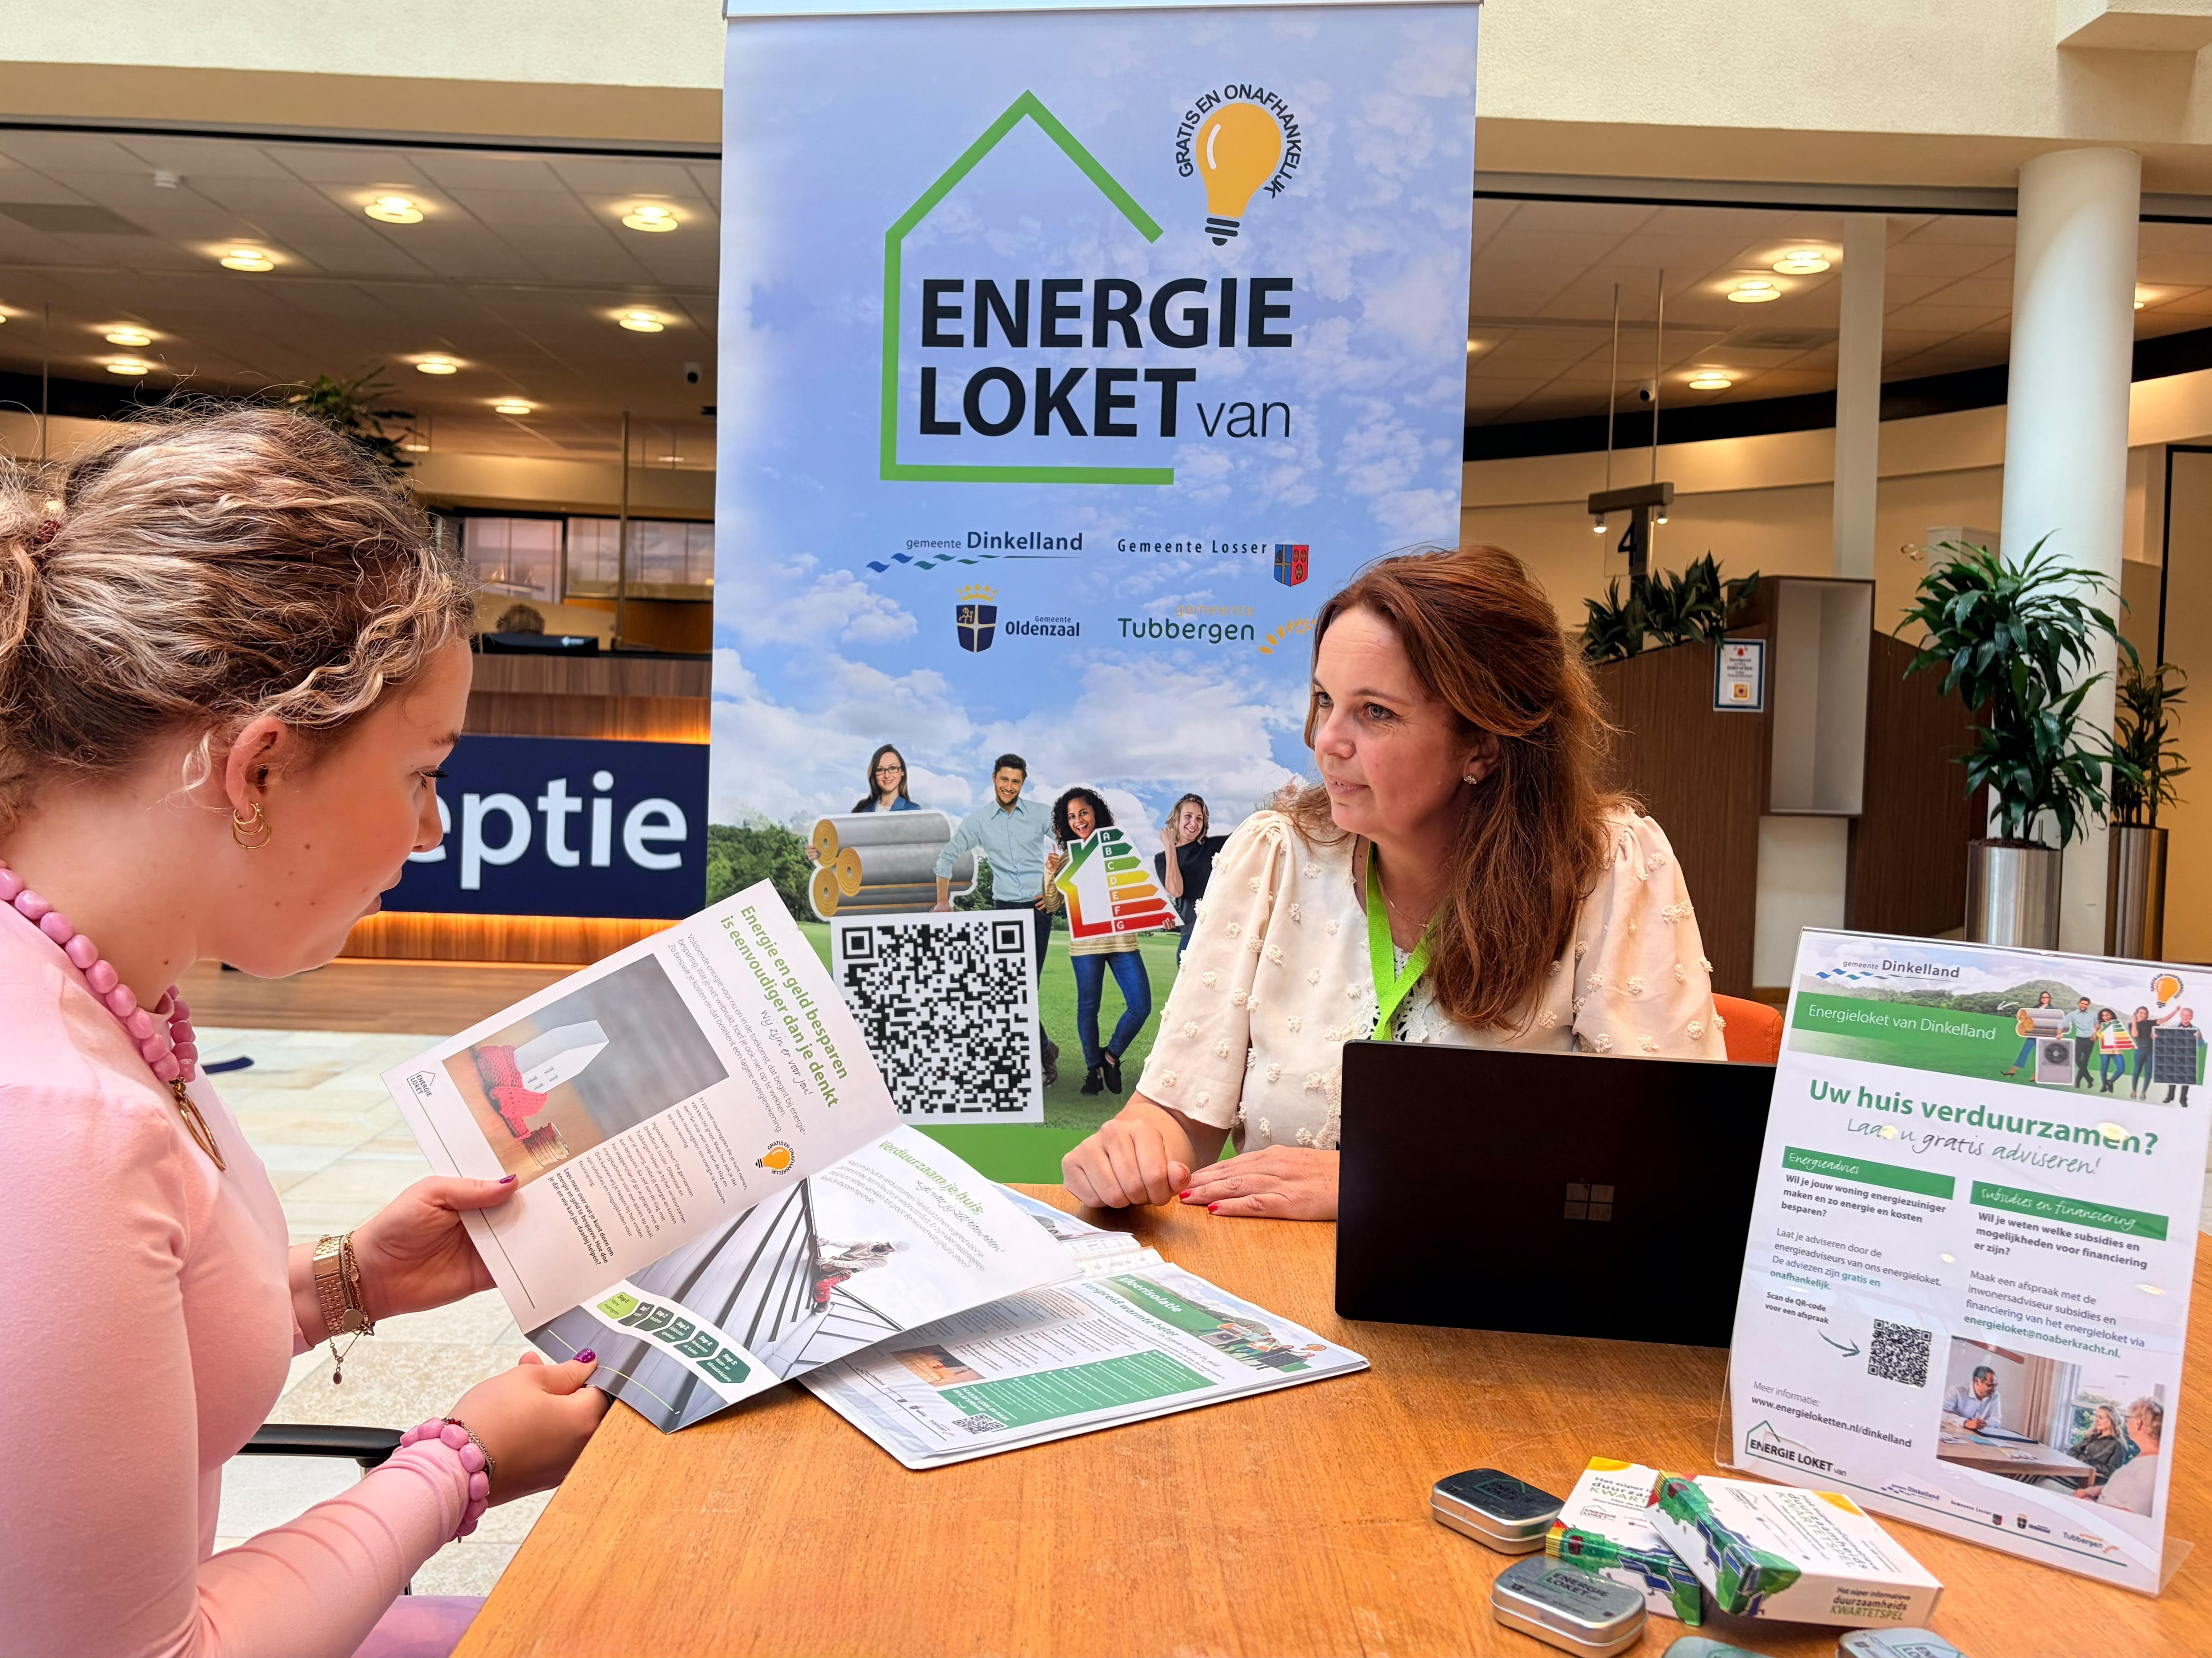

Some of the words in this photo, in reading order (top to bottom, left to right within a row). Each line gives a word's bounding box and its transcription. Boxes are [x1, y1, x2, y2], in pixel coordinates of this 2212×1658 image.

[1176, 108, 1200, 178] GRATIS
[1195, 90, 1221, 114] EN
[1224, 83, 1301, 198] ONAFHANKELIJK
[922, 278, 1293, 347] ENERGIE
[920, 366, 1196, 436] LOKET
[1197, 400, 1290, 438] van
[906, 538, 962, 551] gemeente
[967, 532, 1083, 551] Dinkelland
[1118, 539, 1202, 554] Gemeente
[1212, 540, 1267, 554] Losser
[1618, 521, 1637, 566] 4
[1175, 604, 1254, 617] gemeente
[1005, 621, 1080, 637] Oldenzaal
[1118, 617, 1254, 644] Tubbergen
[1103, 832, 1110, 841] A
[1112, 891, 1119, 900] E
[1115, 906, 1120, 915] F
[1117, 921, 1124, 929] G
[1843, 960, 1878, 970] gemeente
[1882, 959, 1960, 978] Dinkelland
[741, 905, 778, 957] Energie
[775, 959, 790, 976] en
[783, 978, 814, 1009] geld
[805, 1008, 847, 1079] besparen
[721, 916, 734, 929] is
[730, 931, 788, 1012] eenvoudiger
[783, 1016, 804, 1043] dan
[795, 1043, 813, 1060] je
[809, 1062, 838, 1108] denkt
[761, 1010, 778, 1026] Wij
[1809, 1004, 1889, 1026] Energieloket
[1893, 1016, 1916, 1029] van
[1920, 1019, 1996, 1040] Dinkelland
[688, 934, 709, 965] Voldoende
[707, 966, 723, 987] energie
[721, 987, 732, 1000] voor
[730, 1001, 737, 1009] nu
[745, 1025, 752, 1033] de
[750, 1033, 770, 1064] toekomst,
[768, 1065, 777, 1076] dat
[774, 1075, 788, 1098] begint
[791, 1108, 805, 1135] energie-
[697, 968, 706, 980] Wat
[708, 986, 718, 998] niet
[716, 998, 734, 1026] verbruikt,
[733, 1024, 746, 1039] hoef
[745, 1047, 755, 1059] ook
[753, 1059, 763, 1072] niet
[760, 1072, 767, 1081] op
[770, 1089, 785, 1117] wekken.
[769, 1029, 786, 1046] zijn
[788, 1061, 801, 1076] voor
[410, 1077, 423, 1094] LOKET
[416, 1075, 432, 1097] ENERGIE
[793, 1075, 813, 1095] jou!
[1810, 1079, 1851, 1105] Uw
[1857, 1083, 1913, 1115] huis
[1921, 1102, 2158, 1156] verduurzamen?
[767, 1141, 784, 1150] GRATIS
[1848, 1118, 1893, 1141] Laa
[1901, 1130, 1916, 1142] u
[1912, 1132, 1984, 1155] gratis
[1992, 1144, 2101, 1175] adviseren!
[1789, 1153, 1859, 1175] Energieadvies
[939, 1183, 958, 1195] je
[955, 1192, 983, 1215] huis
[1781, 1201, 1827, 1217] besparen?
[1783, 1188, 1812, 1201] maken
[1815, 1194, 1826, 1203] en
[1827, 1197, 1838, 1207] zo
[1840, 1199, 1875, 1213] energie
[1877, 1206, 1888, 1215] en
[1891, 1208, 1923, 1223] kosten
[1786, 1175, 1799, 1184] Wil
[1800, 1178, 1810, 1187] je
[1810, 1179, 1833, 1191] jouw
[1835, 1185, 1869, 1199] woning
[1871, 1191, 1946, 1213] energiezuiniger
[1981, 1188, 2032, 1208] subsidies
[2036, 1201, 2053, 1211] en
[2054, 1202, 2136, 1231] financiering
[1777, 1228, 1794, 1239] Laat
[1795, 1232, 1803, 1242] je
[1805, 1234, 1846, 1251] adviseren
[1847, 1242, 1869, 1255] door
[1870, 1247, 1882, 1258] de
[1978, 1212, 1994, 1222] Wil
[1995, 1215, 2005, 1226] je
[2008, 1219, 2039, 1231] weten
[2042, 1224, 2072, 1237] welke
[2074, 1231, 2124, 1248] subsidies
[2126, 1242, 2140, 1251] en
[1774, 1242, 1845, 1265] energieadviseurs
[1847, 1258, 1862, 1268] van
[1865, 1261, 1881, 1272] ons
[1882, 1265, 1942, 1286] energieloket.
[1974, 1242, 1985, 1250] er
[1986, 1243, 2010, 1256] zijn?
[1976, 1227, 2053, 1250] mogelijkheden
[2056, 1243, 2080, 1254] voor
[2082, 1248, 2148, 1270] financiering
[1770, 1269, 1831, 1290] onafhankelijk.
[1772, 1255, 1784, 1264] De
[1786, 1258, 1823, 1274] adviezen
[1824, 1266, 1840, 1278] zijn
[1842, 1271, 1867, 1285] gratis
[1869, 1278, 1881, 1287] en
[1119, 1277, 1182, 1312] Vloerisolatie
[1767, 1292, 1783, 1302] Scan
[1785, 1296, 1794, 1304] de
[1795, 1299, 1826, 1312] QR-code
[1970, 1270, 1996, 1283] Maak
[1997, 1277, 2015, 1288] een
[2018, 1280, 2059, 1296] afspraak
[2061, 1290, 2081, 1302] met
[2083, 1294, 2096, 1305] de
[1081, 1282, 1125, 1305] Verspreid
[1119, 1302, 1154, 1325] warmte
[1151, 1323, 1180, 1337] beter
[1765, 1303, 1781, 1312] voor
[1783, 1307, 1796, 1315] een
[1797, 1309, 1829, 1324] afspraak
[1968, 1285, 2053, 1311] inwonersadviseur
[2055, 1304, 2101, 1323] subsidies
[2103, 1315, 2116, 1325] en
[1964, 1314, 2121, 1359] energieloket@noaberkracht.nl.
[1966, 1299, 2023, 1321] financiering
[2025, 1313, 2043, 1324] van
[2045, 1317, 2063, 1329] het
[2064, 1322, 2128, 1343] energieloket
[2129, 1335, 2145, 1347] via
[1753, 1381, 1774, 1394] Meer
[1776, 1386, 1821, 1407] informatie:
[1751, 1397, 1912, 1448] www.energieloketten.nl/dinkelland
[1750, 1439, 1796, 1461] ENERGIE
[1797, 1452, 1834, 1472] LOKET
[1834, 1467, 1847, 1477] van
